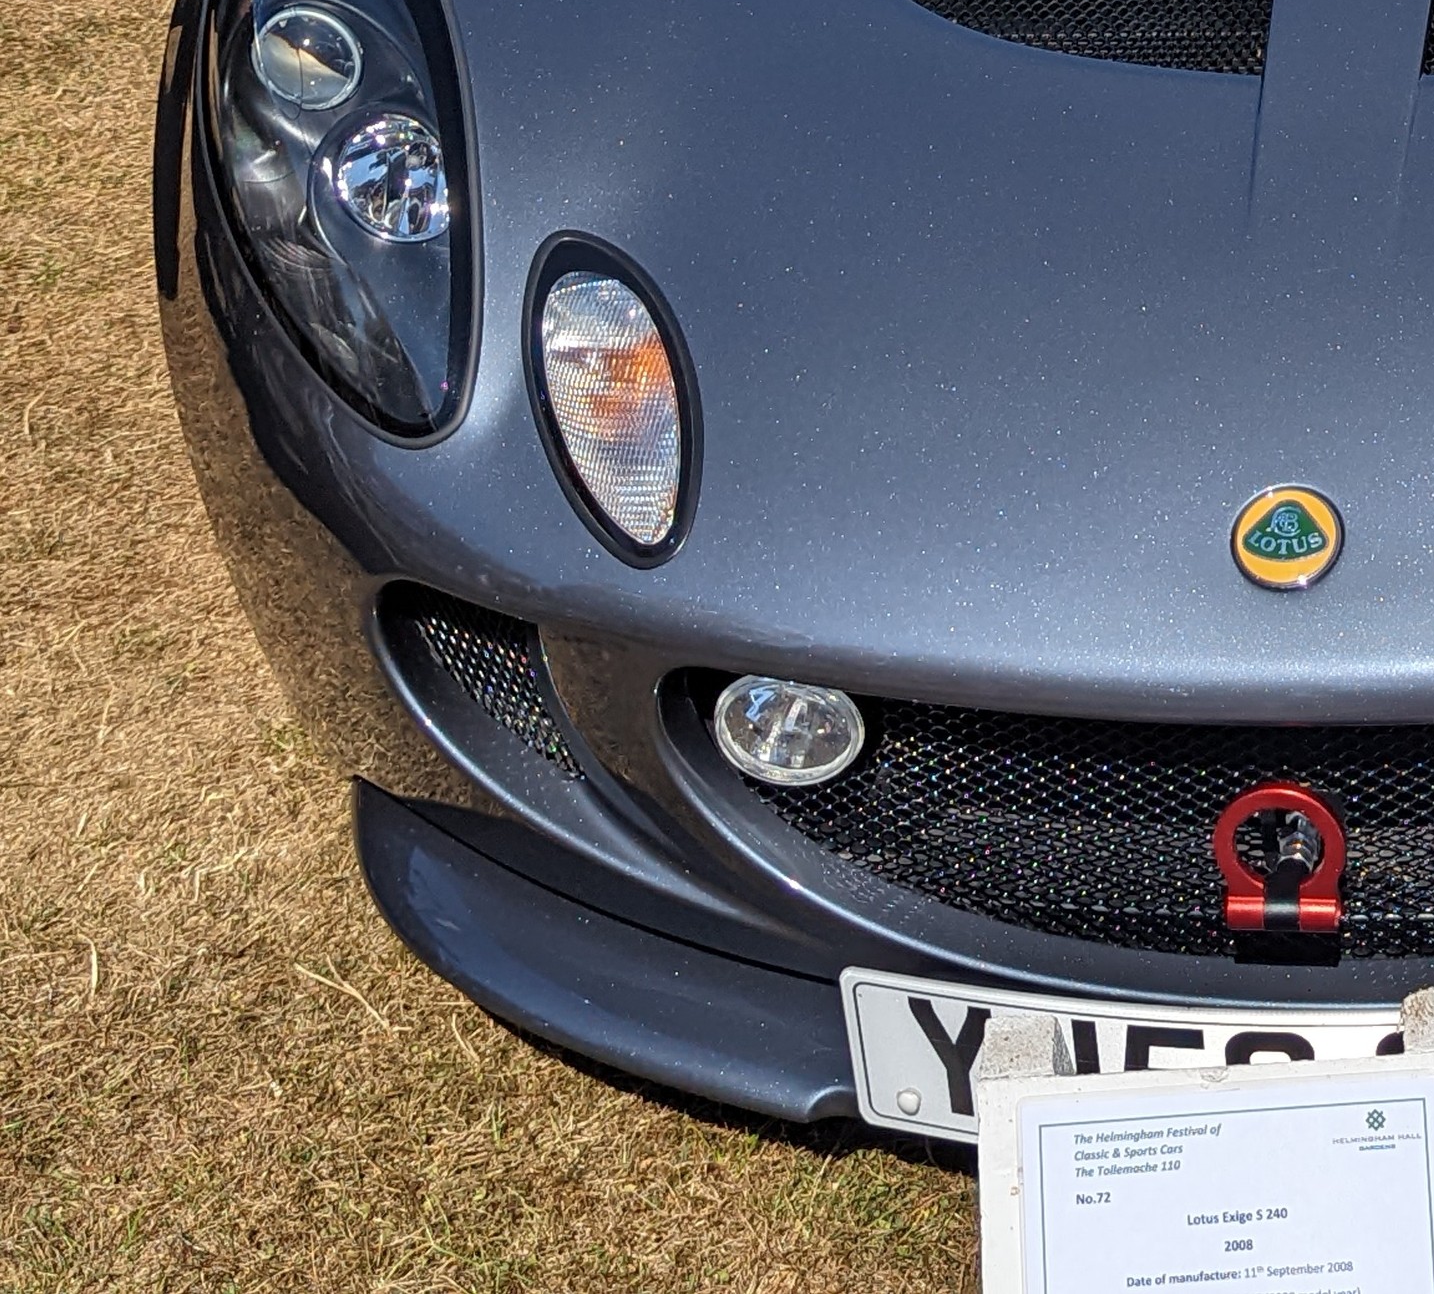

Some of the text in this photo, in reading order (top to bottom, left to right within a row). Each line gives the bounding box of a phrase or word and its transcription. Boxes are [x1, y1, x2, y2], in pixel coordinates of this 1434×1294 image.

[1248, 529, 1323, 555] LOTUS
[1074, 1123, 1222, 1145] The Helmingham Festival of
[1074, 1144, 1183, 1161] Classic & Sports Cars
[1075, 1160, 1181, 1178] The Tollemache 110
[1076, 1192, 1111, 1205] No.72
[1187, 1207, 1288, 1226] Lotus Exige S 240
[1224, 1239, 1254, 1252] 2008
[1127, 1275, 1152, 1288] Date
[1155, 1273, 1166, 1285] of
[1169, 1270, 1242, 1285] manufacture:
[1266, 1263, 1325, 1279] September
[1327, 1261, 1354, 1273] 2008
